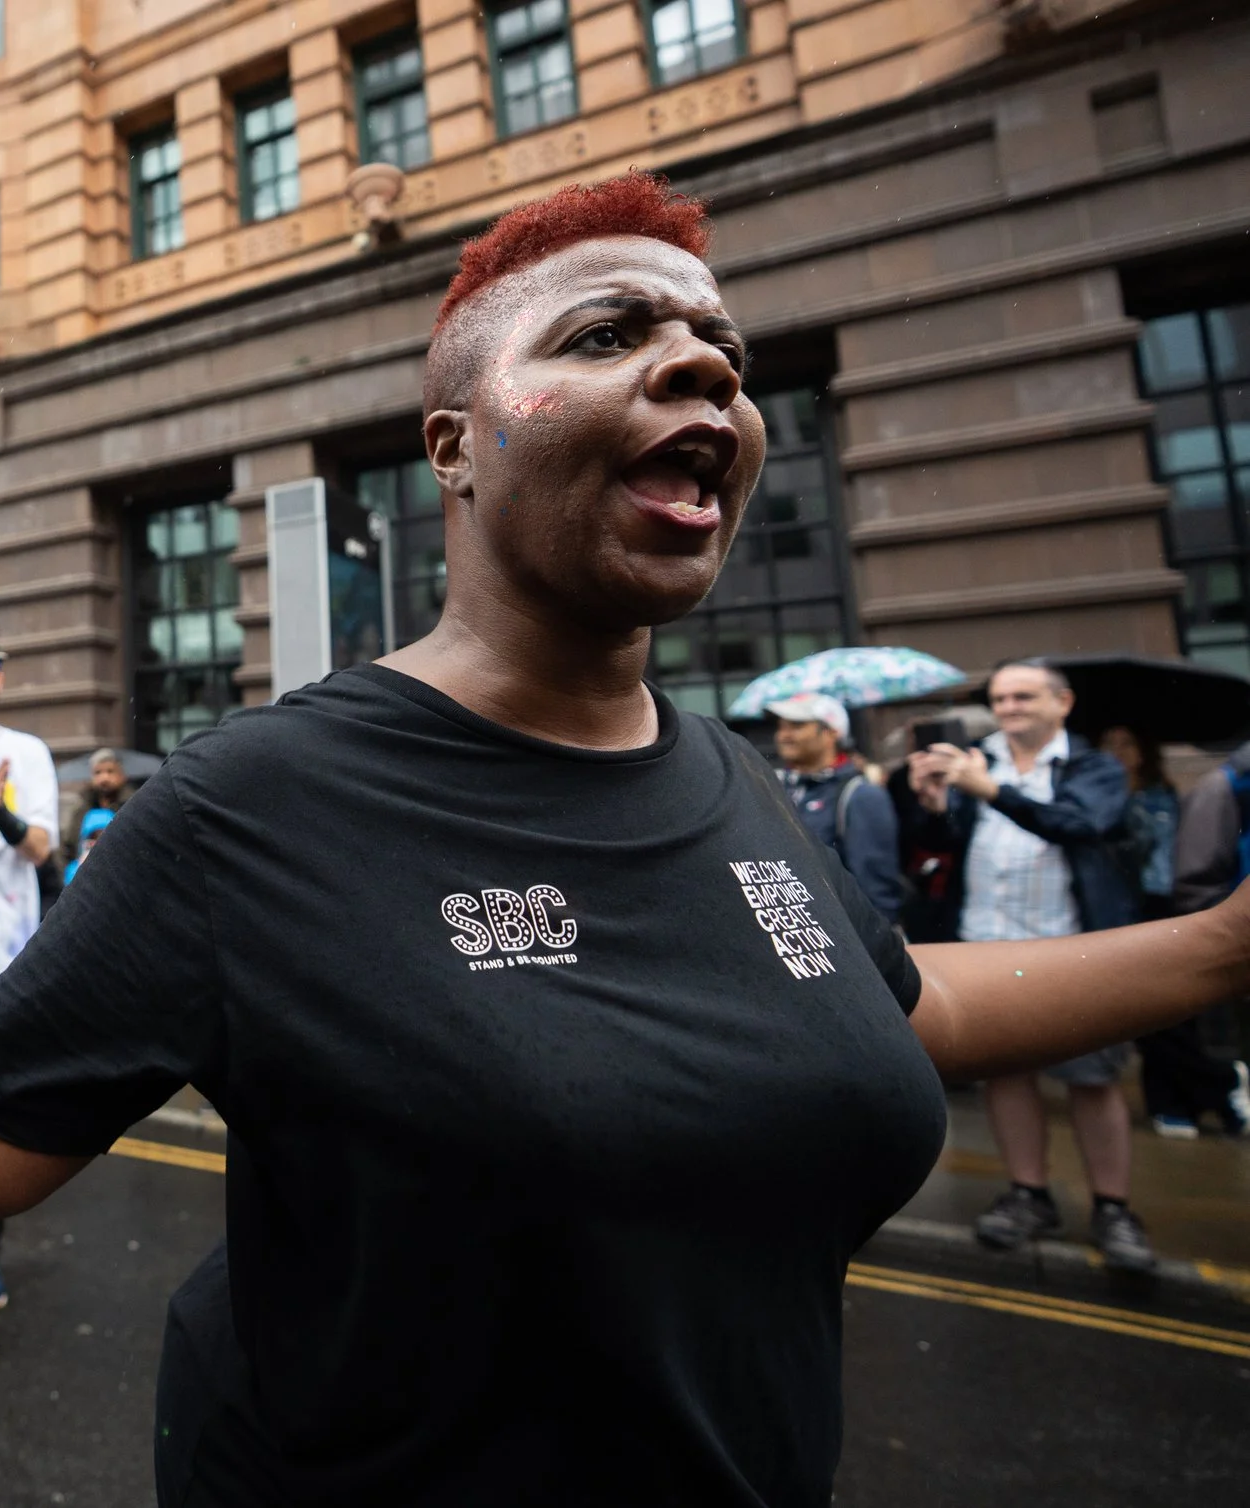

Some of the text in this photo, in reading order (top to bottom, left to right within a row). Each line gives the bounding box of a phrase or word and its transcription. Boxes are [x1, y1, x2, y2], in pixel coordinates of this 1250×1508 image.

[729, 860, 798, 885] WELCOME
[741, 881, 815, 909] EMPOWER
[441, 884, 578, 956] SBC
[755, 904, 819, 933] CREATE
[771, 925, 835, 957] ACTION
[469, 954, 578, 971] STAND & BE COUNTED
[782, 951, 837, 980] NOW
